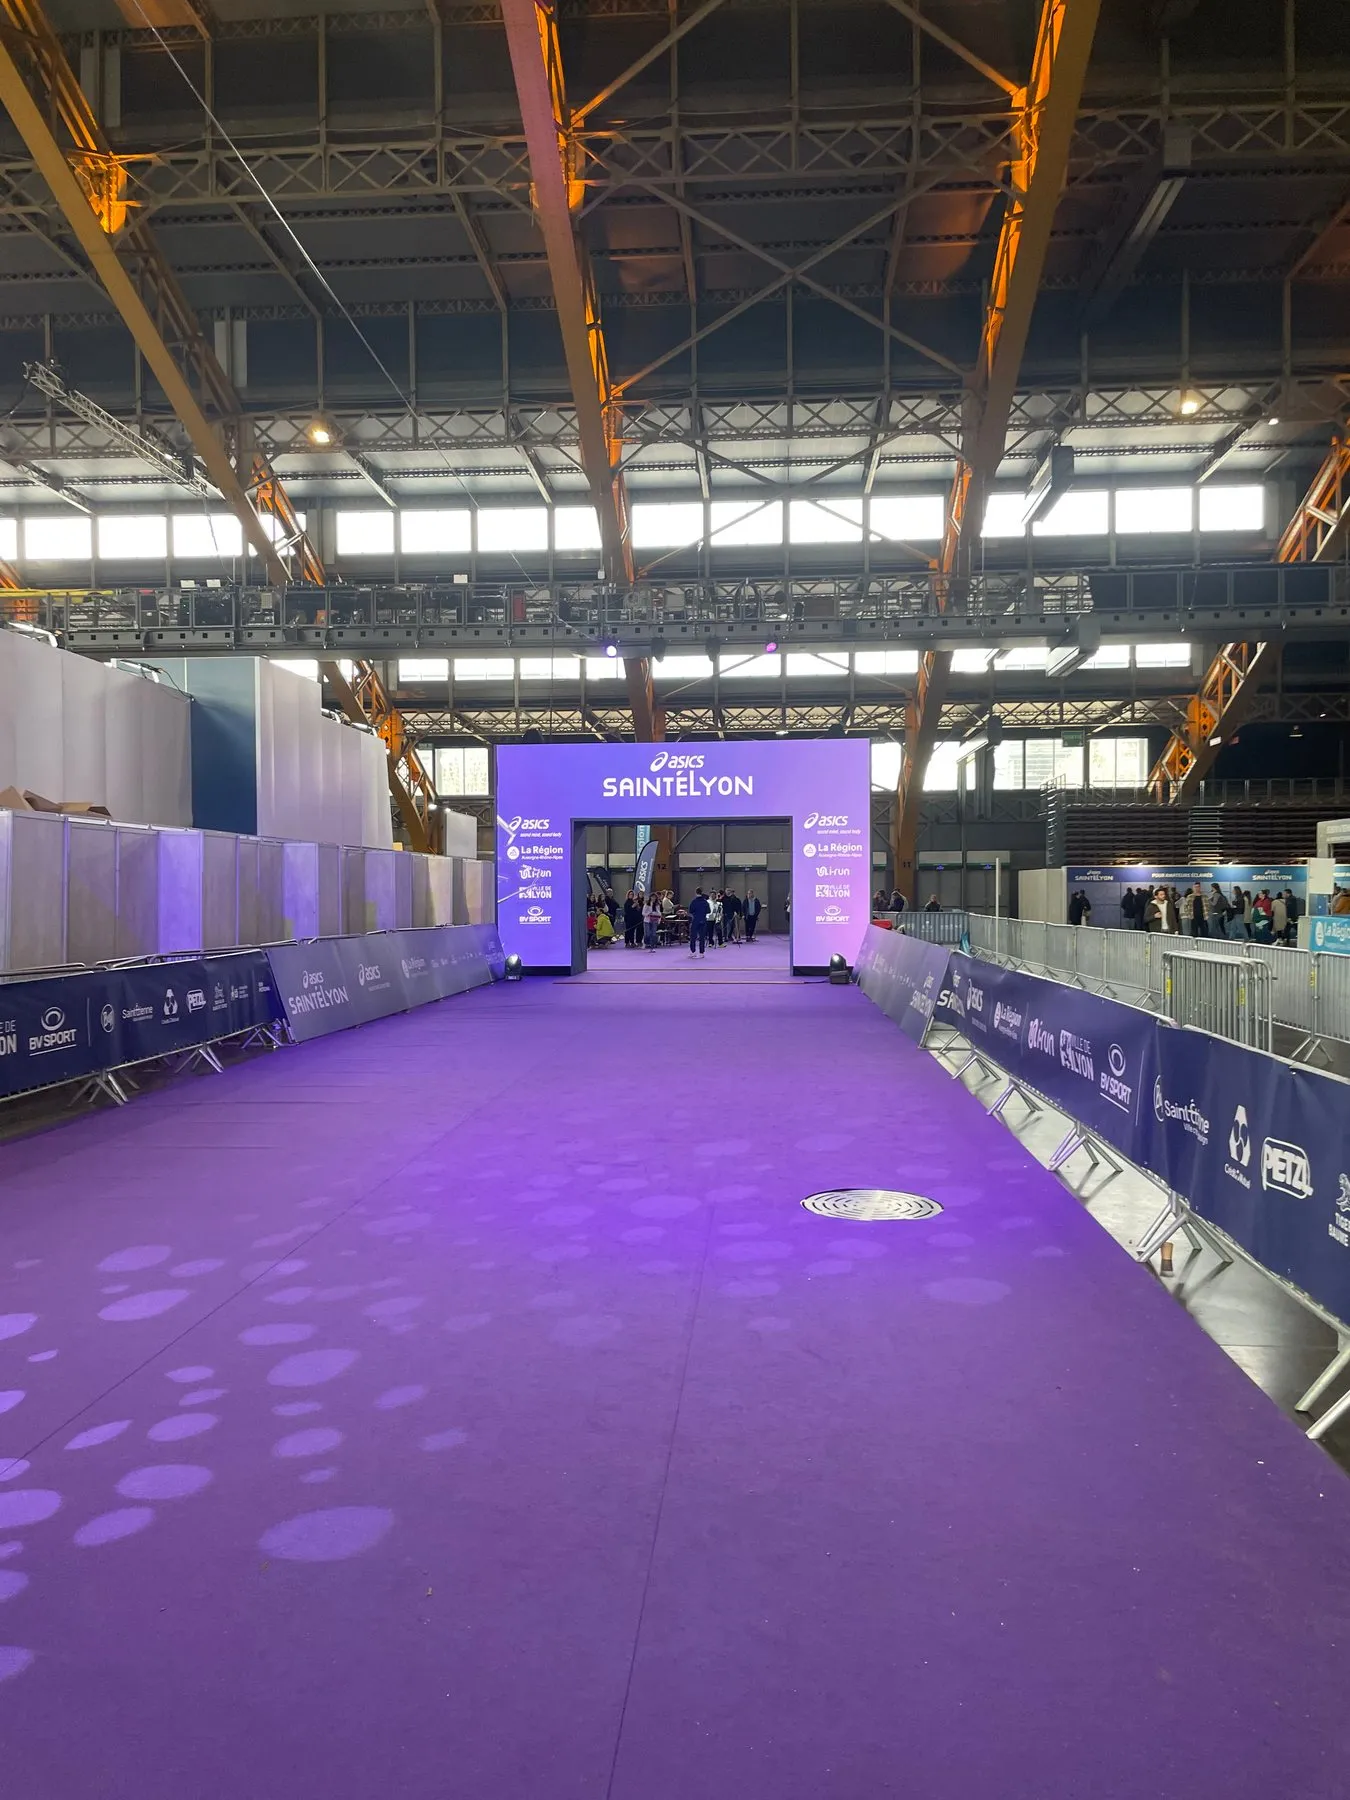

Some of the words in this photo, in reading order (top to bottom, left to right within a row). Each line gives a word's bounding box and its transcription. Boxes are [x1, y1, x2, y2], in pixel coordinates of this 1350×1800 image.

[668, 755, 704, 769] asics
[603, 770, 753, 797] SAINTÉLYON
[521, 819, 550, 830] asics
[818, 816, 849, 827] asics
[521, 846, 531, 854] La
[532, 845, 563, 856] Région
[818, 844, 829, 852] La
[830, 843, 863, 854] Région
[829, 867, 850, 876] i-run
[532, 890, 552, 899] LYON
[829, 889, 850, 898] LYON
[309, 971, 325, 985] asics
[365, 965, 381, 981] asics
[289, 985, 350, 1015] SAINTÉLYON
[5, 1020, 16, 1033] DE
[29, 1036, 43, 1051] BV
[44, 1028, 77, 1048] SPORT
[1070, 1050, 1094, 1081] LYON
[1101, 1071, 1110, 1091] BV
[1109, 1077, 1132, 1105] SPORT
[1262, 1142, 1314, 1196] PETZL
